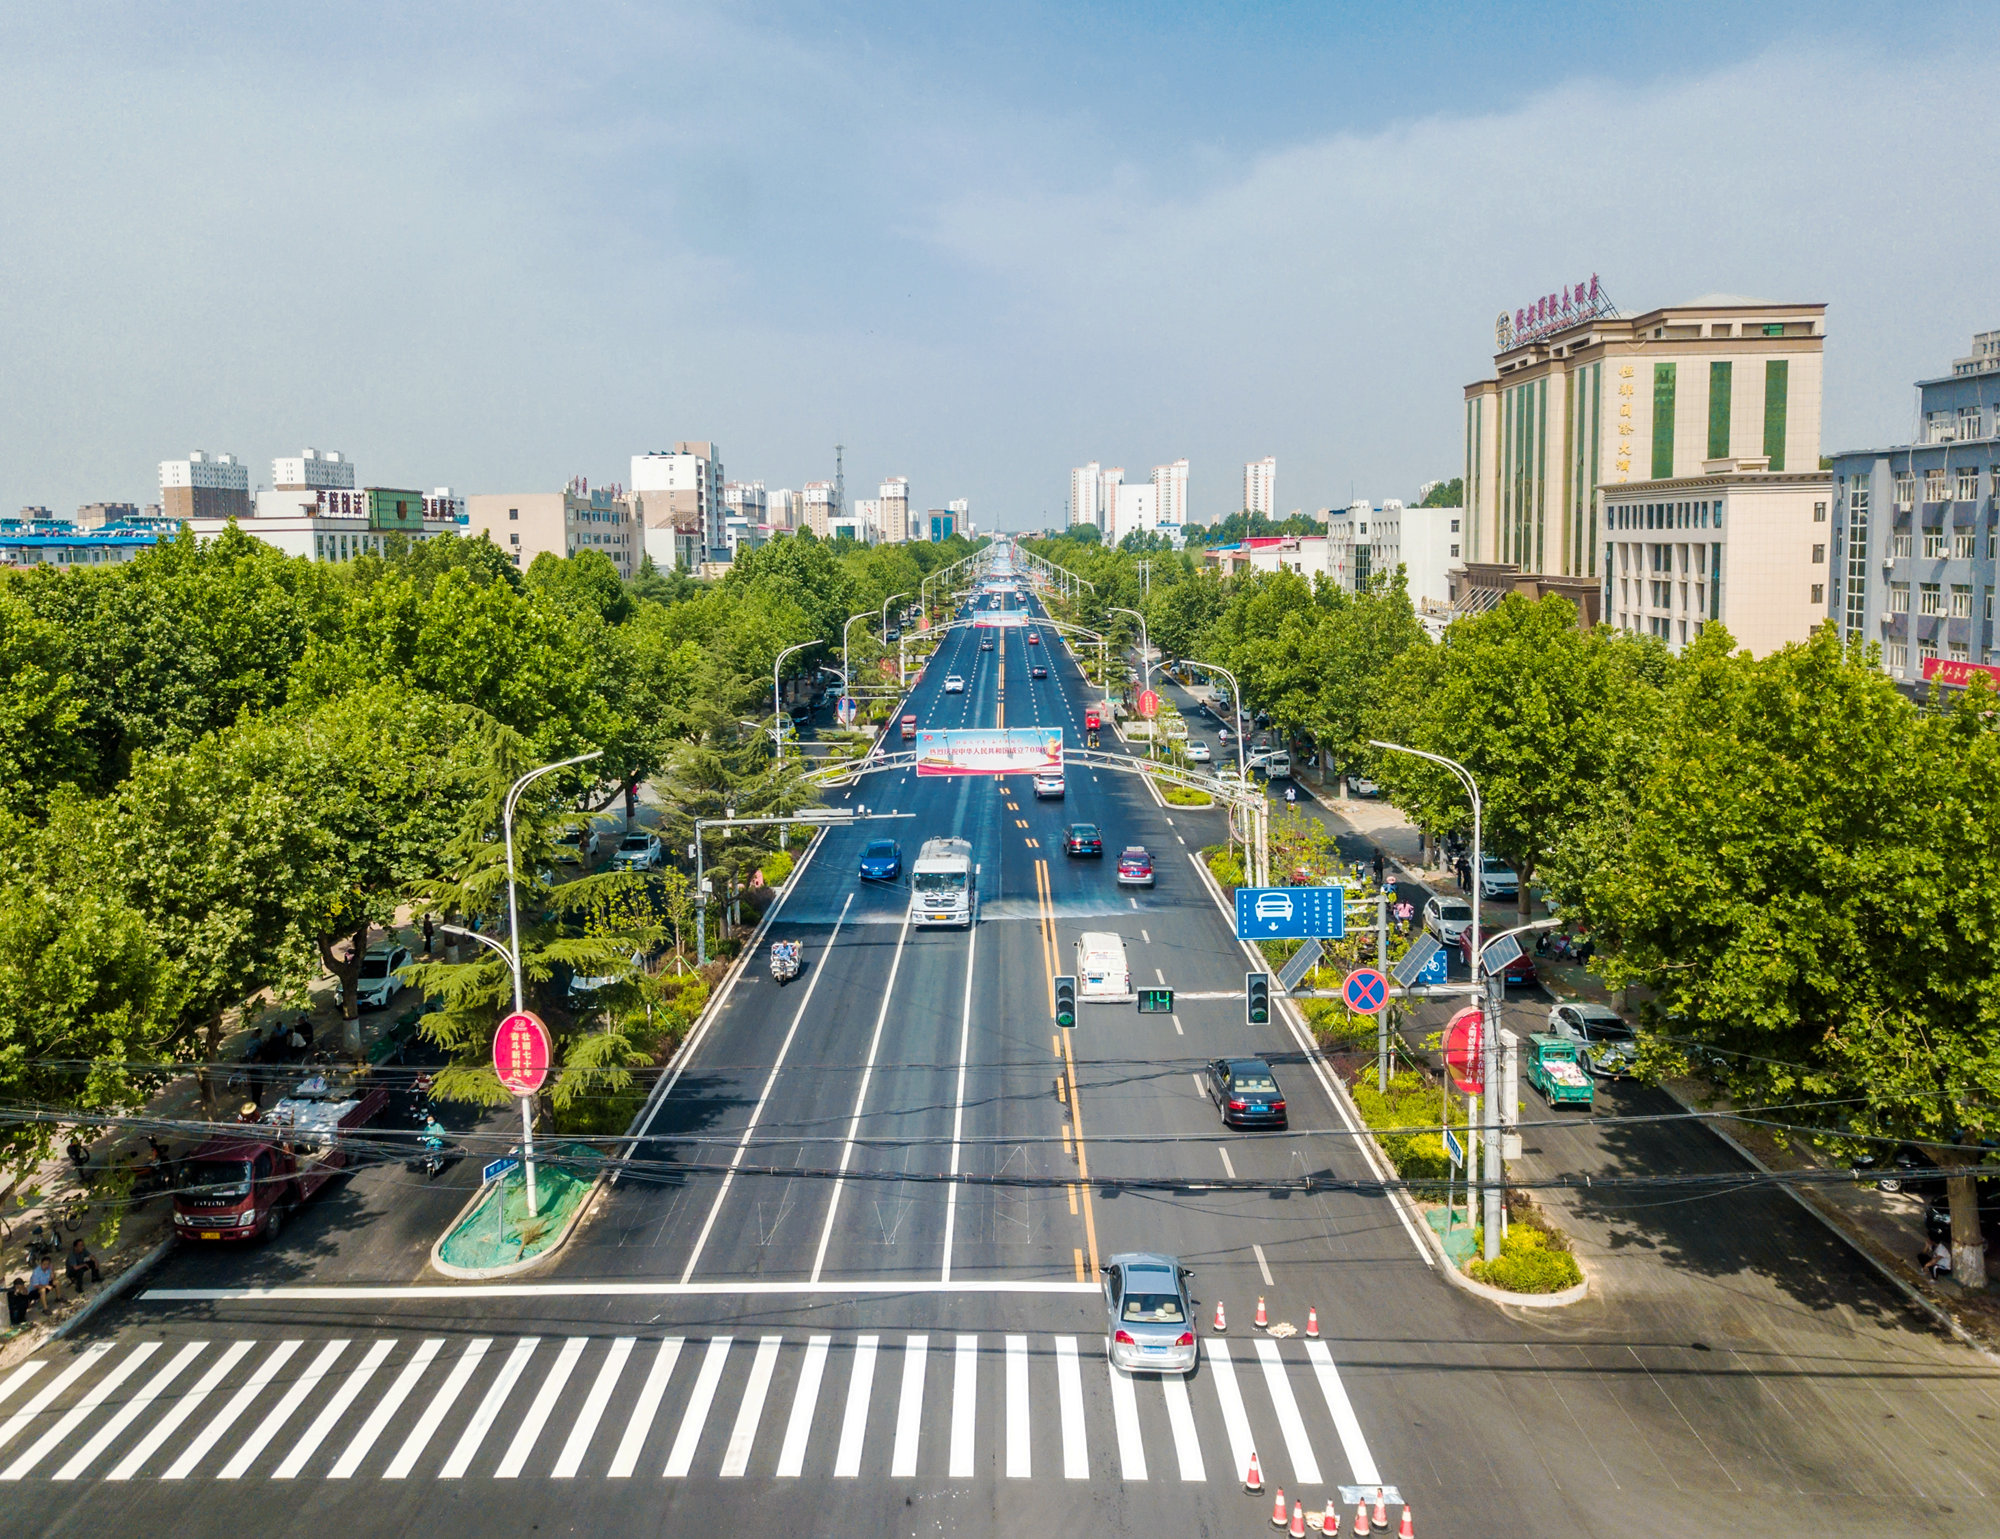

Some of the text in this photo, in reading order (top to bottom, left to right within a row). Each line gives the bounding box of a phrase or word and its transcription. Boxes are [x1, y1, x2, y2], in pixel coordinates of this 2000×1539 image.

[1149, 991, 1170, 1010] 14
[511, 1032, 522, 1077] 奋斗新时代
[521, 1032, 533, 1078] 壮丽七十年
